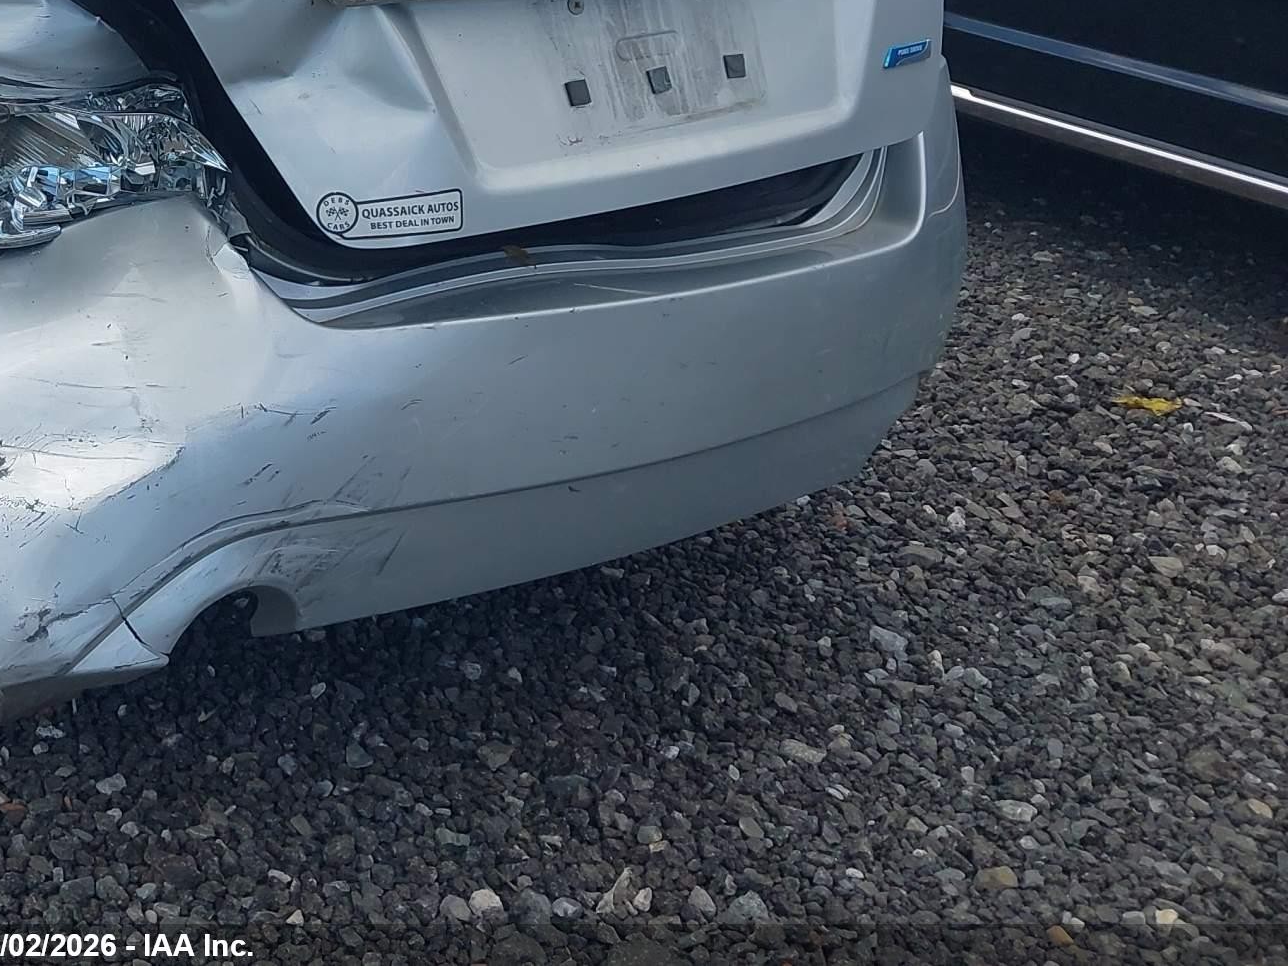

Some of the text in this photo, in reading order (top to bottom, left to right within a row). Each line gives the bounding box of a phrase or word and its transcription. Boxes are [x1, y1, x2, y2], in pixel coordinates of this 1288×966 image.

[362, 201, 459, 219] QUASSAICK AUTOS
[370, 216, 455, 230] BEST DEAL IN TOWN
